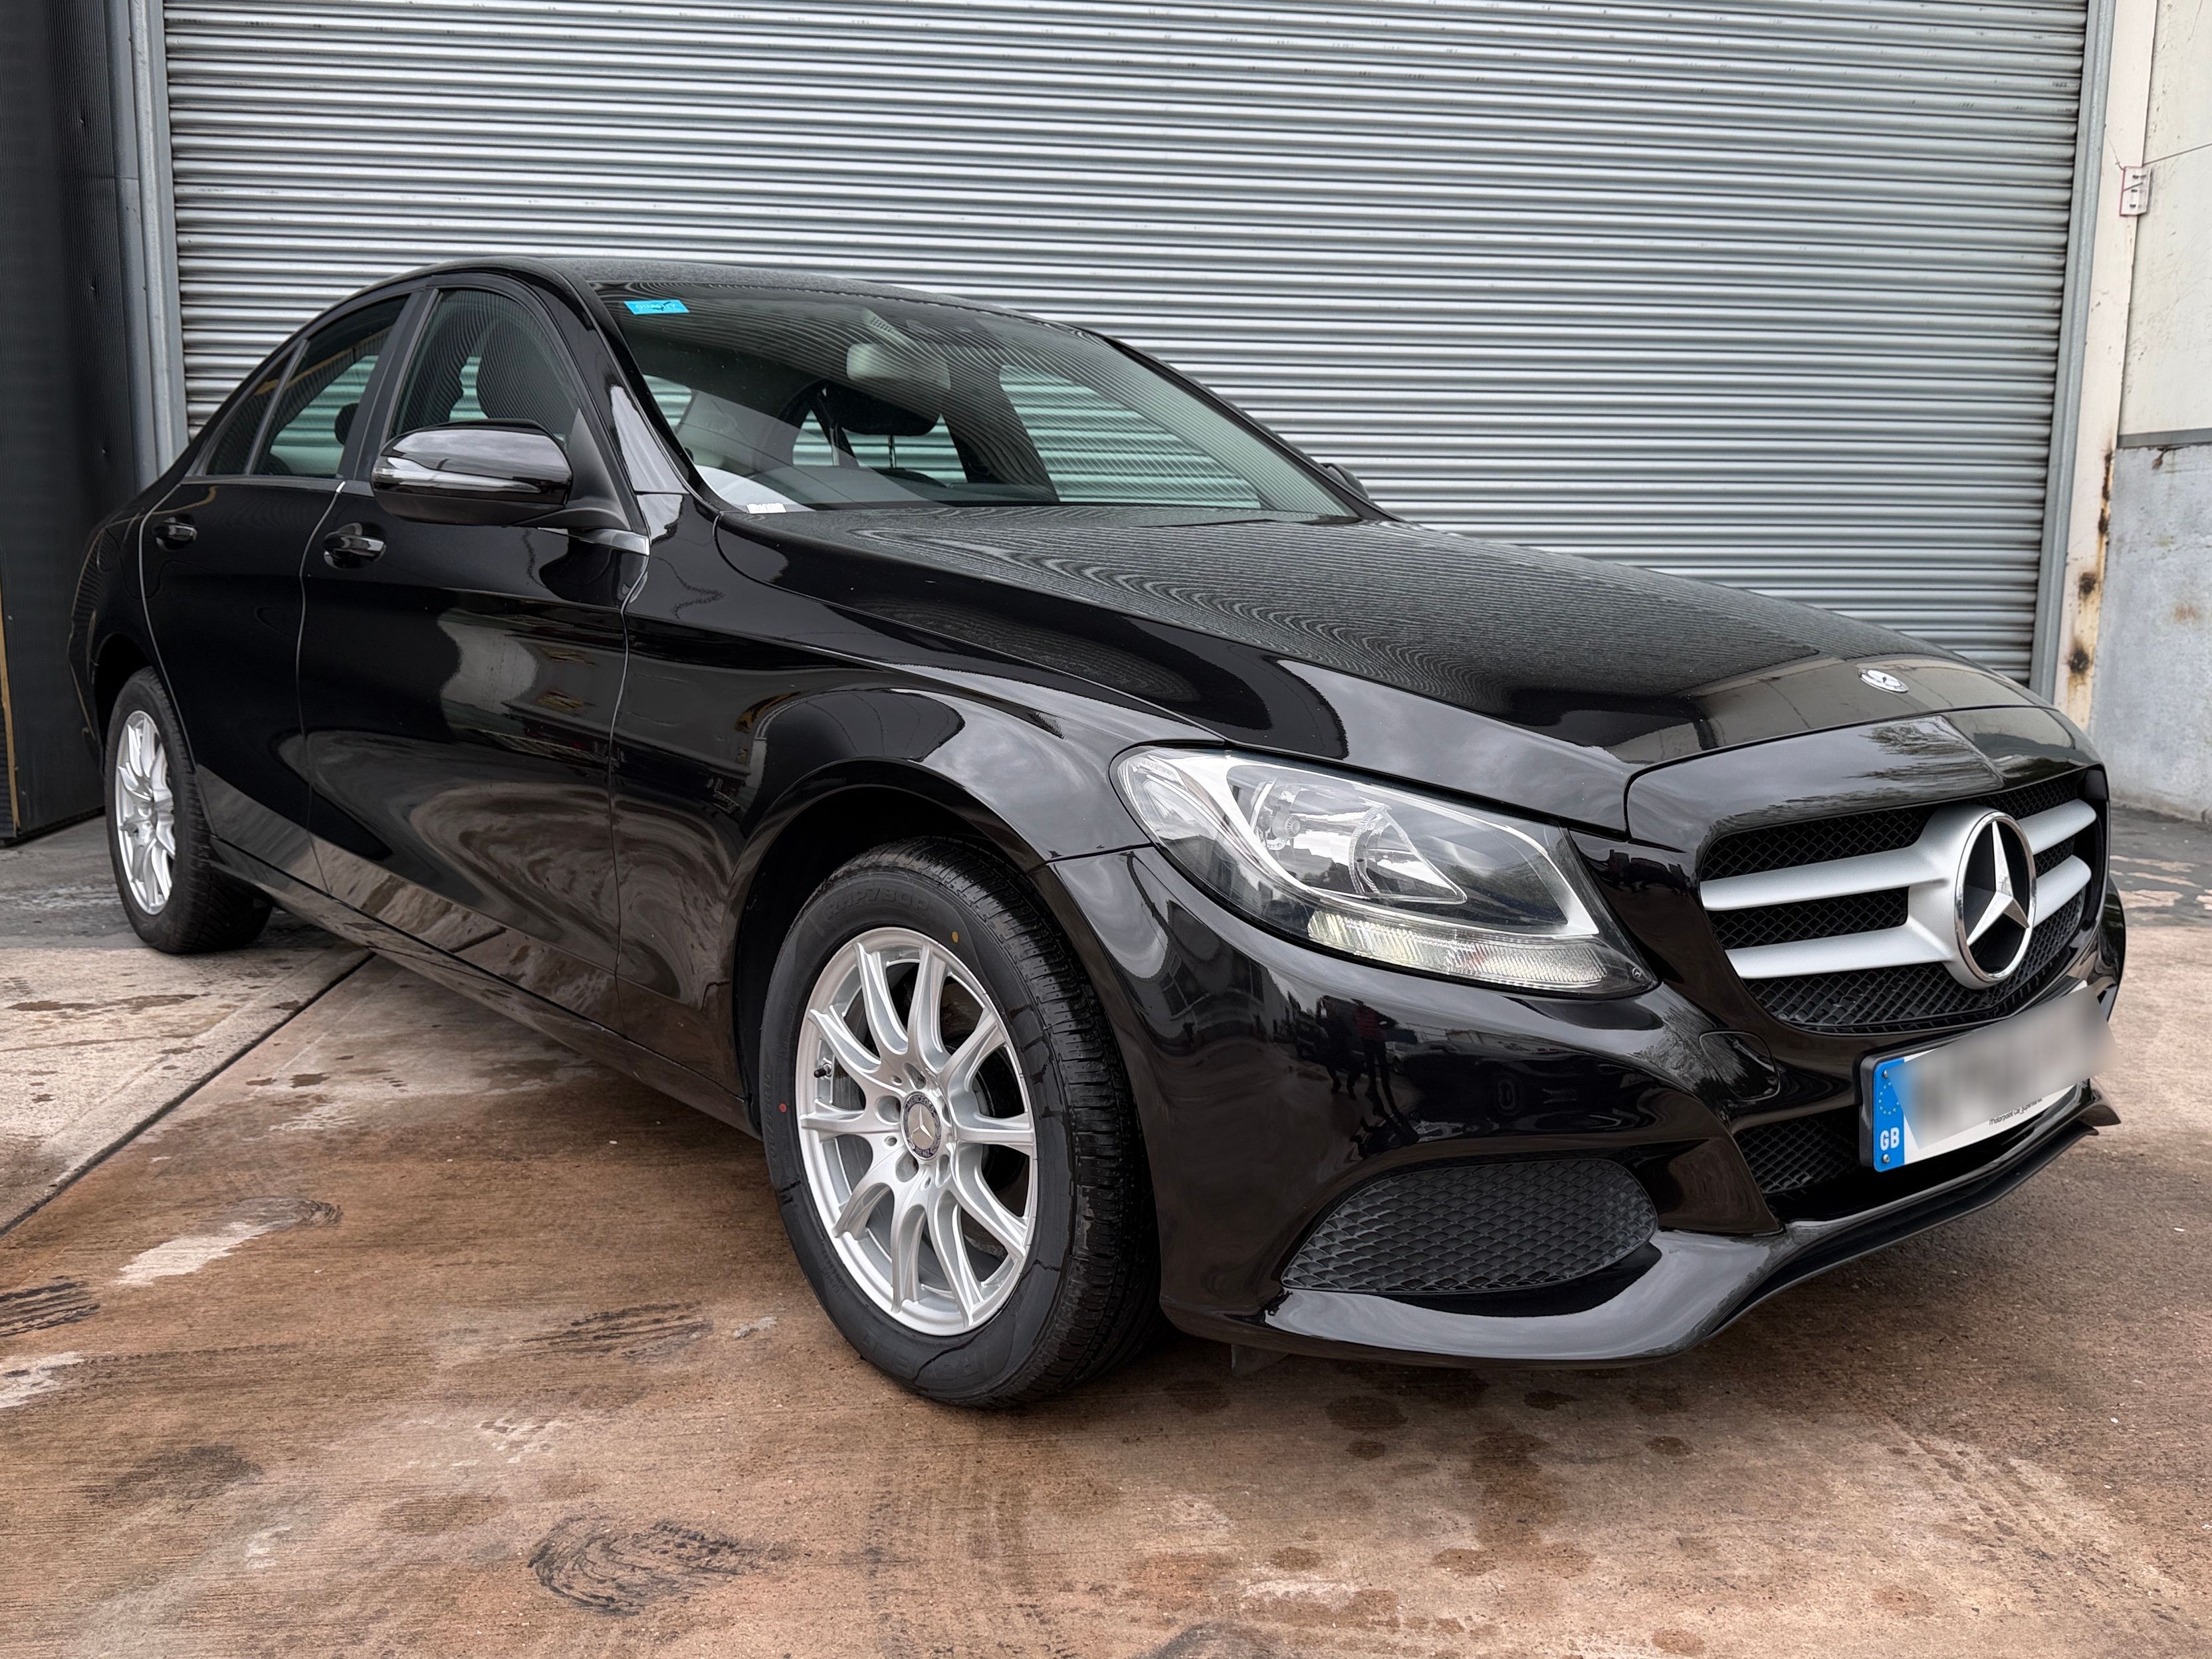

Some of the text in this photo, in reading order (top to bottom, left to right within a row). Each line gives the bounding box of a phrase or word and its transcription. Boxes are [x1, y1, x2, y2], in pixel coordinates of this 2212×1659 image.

[907, 1095, 936, 1113] MERCEDES
[1880, 1127, 1900, 1151] GB
[915, 1147, 931, 1157] BENZ
